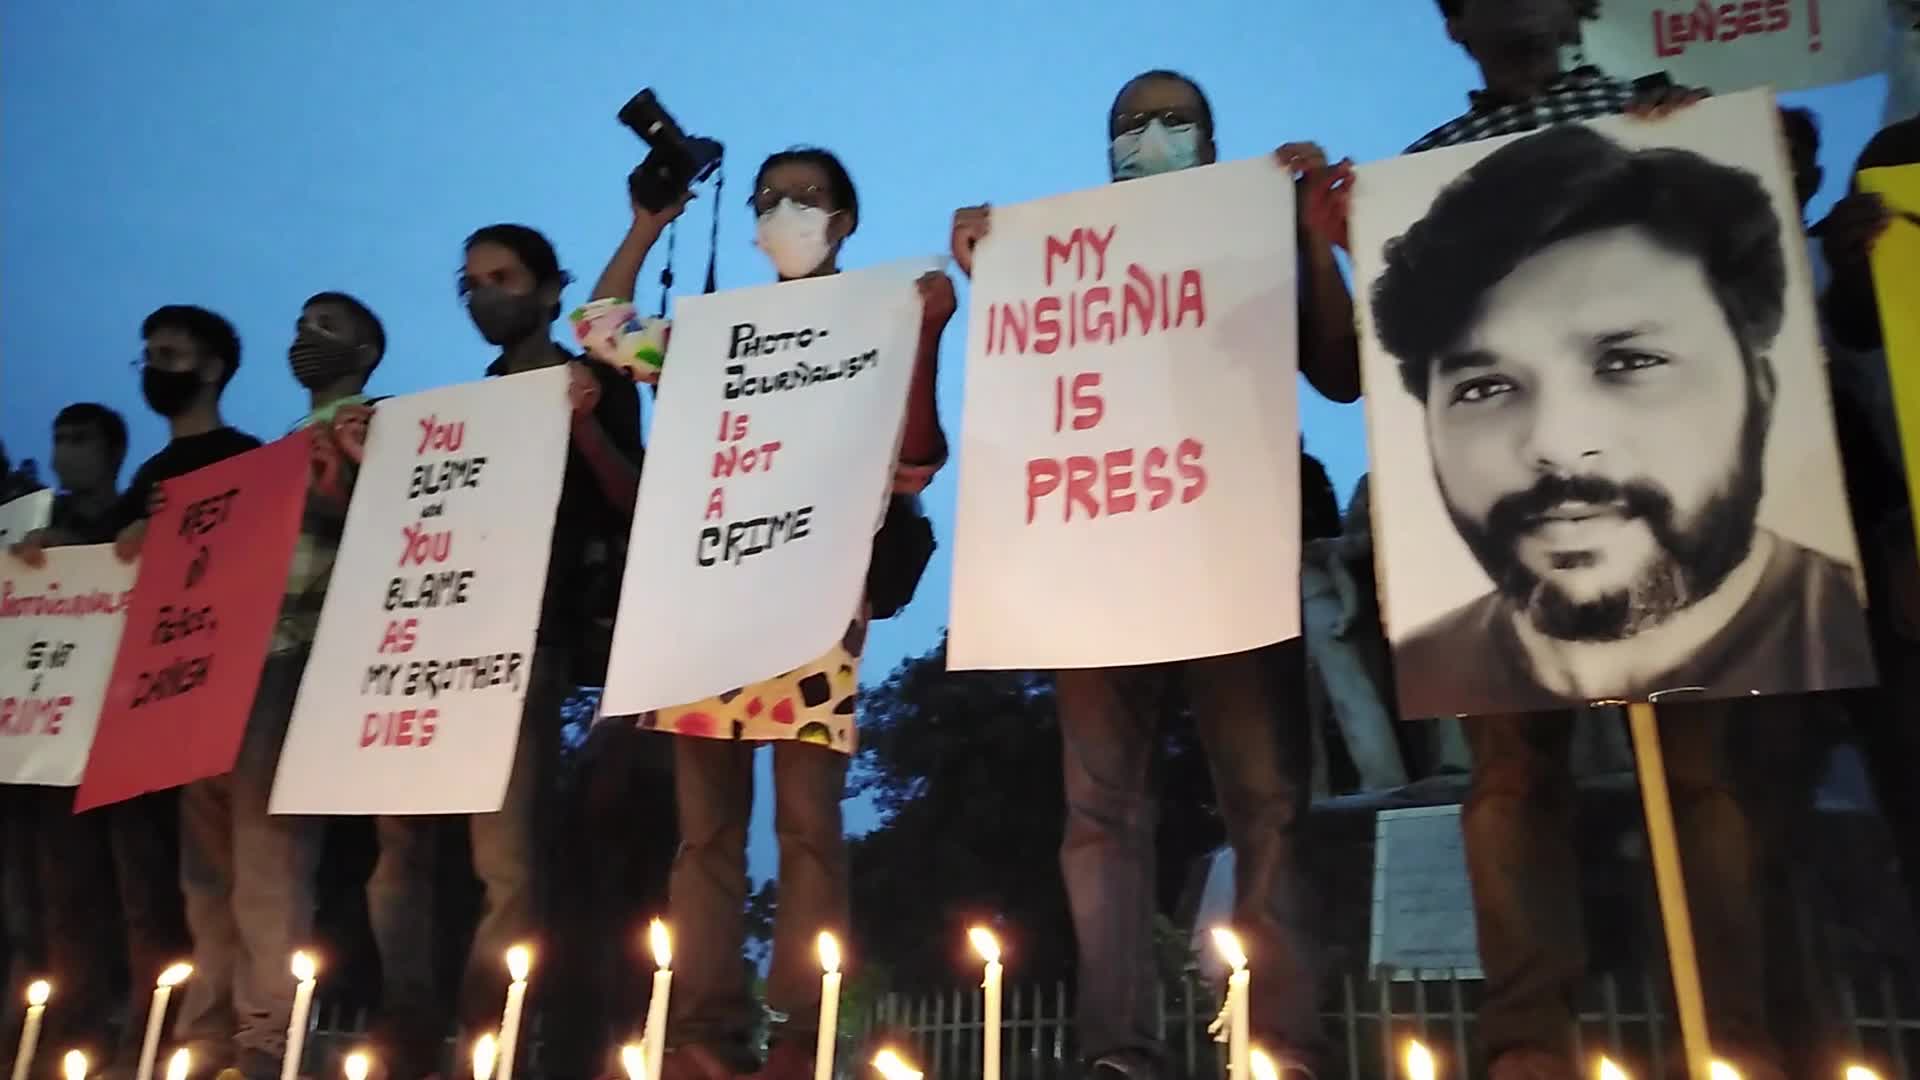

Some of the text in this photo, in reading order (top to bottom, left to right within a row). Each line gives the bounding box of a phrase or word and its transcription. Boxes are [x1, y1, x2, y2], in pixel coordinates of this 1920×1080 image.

[1653, 0, 1789, 56] LENSES
[1045, 224, 1117, 286] MY
[985, 263, 1206, 356] INSIGNIA
[1054, 372, 1106, 433] IS
[417, 414, 465, 456] YOU
[408, 457, 487, 500] BLAME
[711, 441, 782, 478] NOT
[1025, 438, 1209, 525] PRESS
[704, 487, 724, 520] A
[398, 522, 452, 567] YOU
[697, 506, 814, 568] CRIME
[384, 570, 473, 611] BLAME
[377, 619, 418, 654] AS
[361, 652, 521, 699] MY BROTHER
[360, 708, 439, 747] DIES
